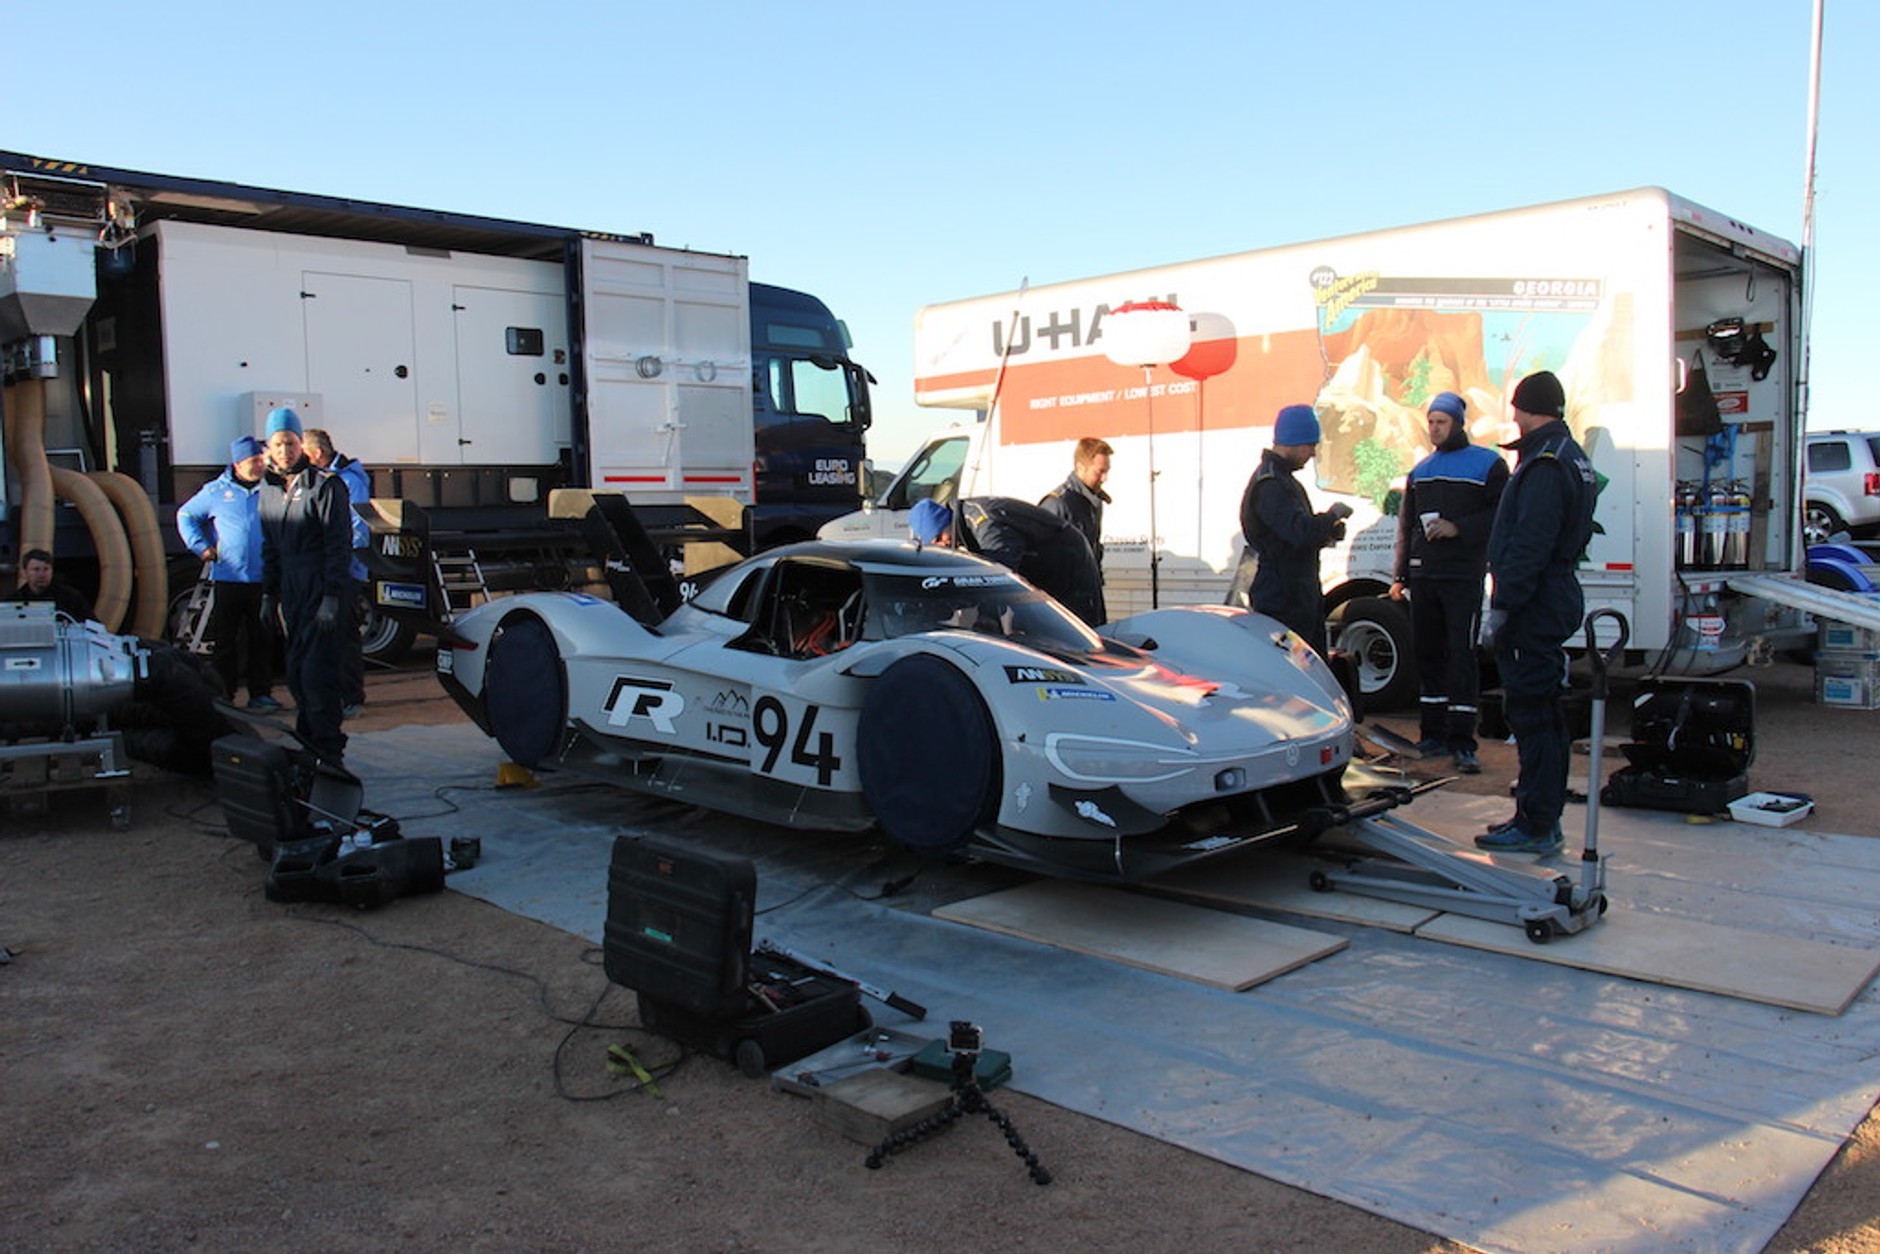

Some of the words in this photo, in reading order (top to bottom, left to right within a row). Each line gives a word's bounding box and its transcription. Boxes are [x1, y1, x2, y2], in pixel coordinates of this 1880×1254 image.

[1512, 279, 1599, 296] GEORGIA
[1029, 396, 1056, 410] RIGHT
[1059, 389, 1115, 406] EQUIPMENT
[1168, 380, 1197, 393] COST
[815, 459, 848, 471] EURO
[808, 472, 855, 484] LEASING
[601, 674, 686, 735] R
[752, 695, 842, 787] 94
